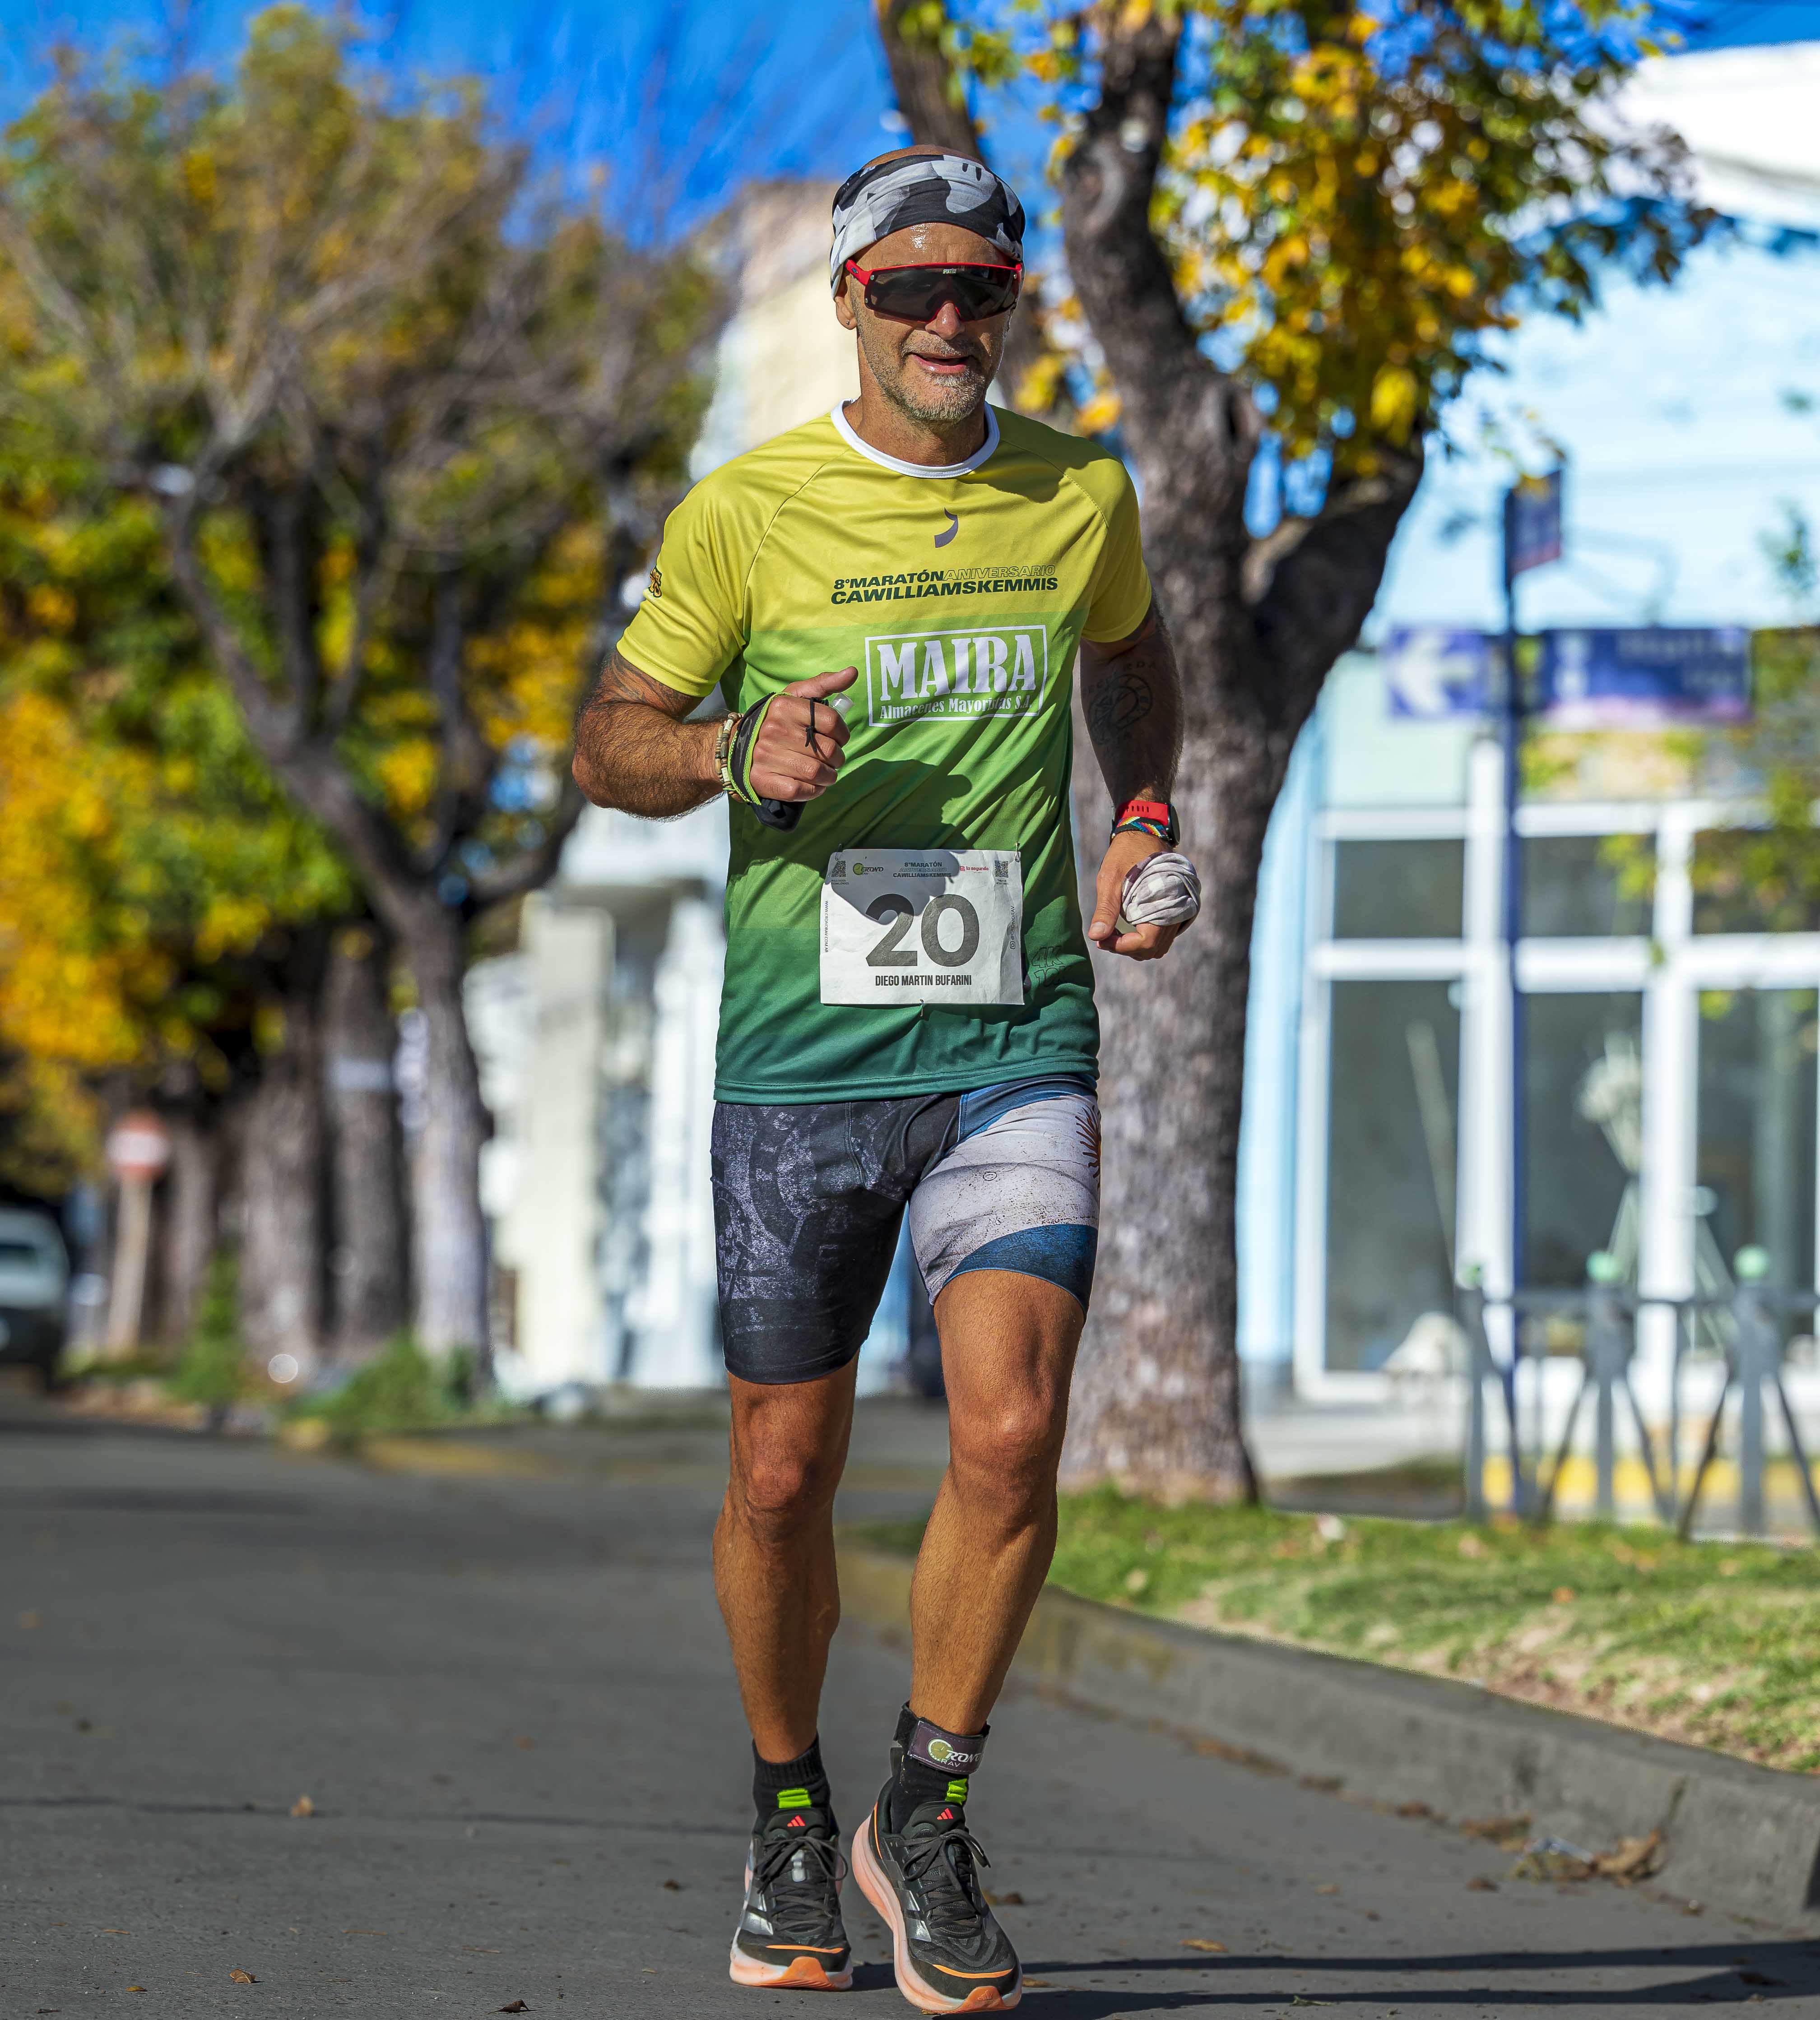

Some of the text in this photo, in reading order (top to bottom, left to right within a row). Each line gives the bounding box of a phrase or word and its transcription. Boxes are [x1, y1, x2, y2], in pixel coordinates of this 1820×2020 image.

[831, 577, 1058, 605] CAWILLIAMSKEMMIS
[877, 635, 1037, 701] MAIRA
[880, 695, 1032, 719] Almacenes Mayoristas S.A.
[865, 893, 980, 967] 20
[875, 974, 972, 987] DIEGO MARTIN BUFARINI
[941, 1758, 961, 1768] RAV
